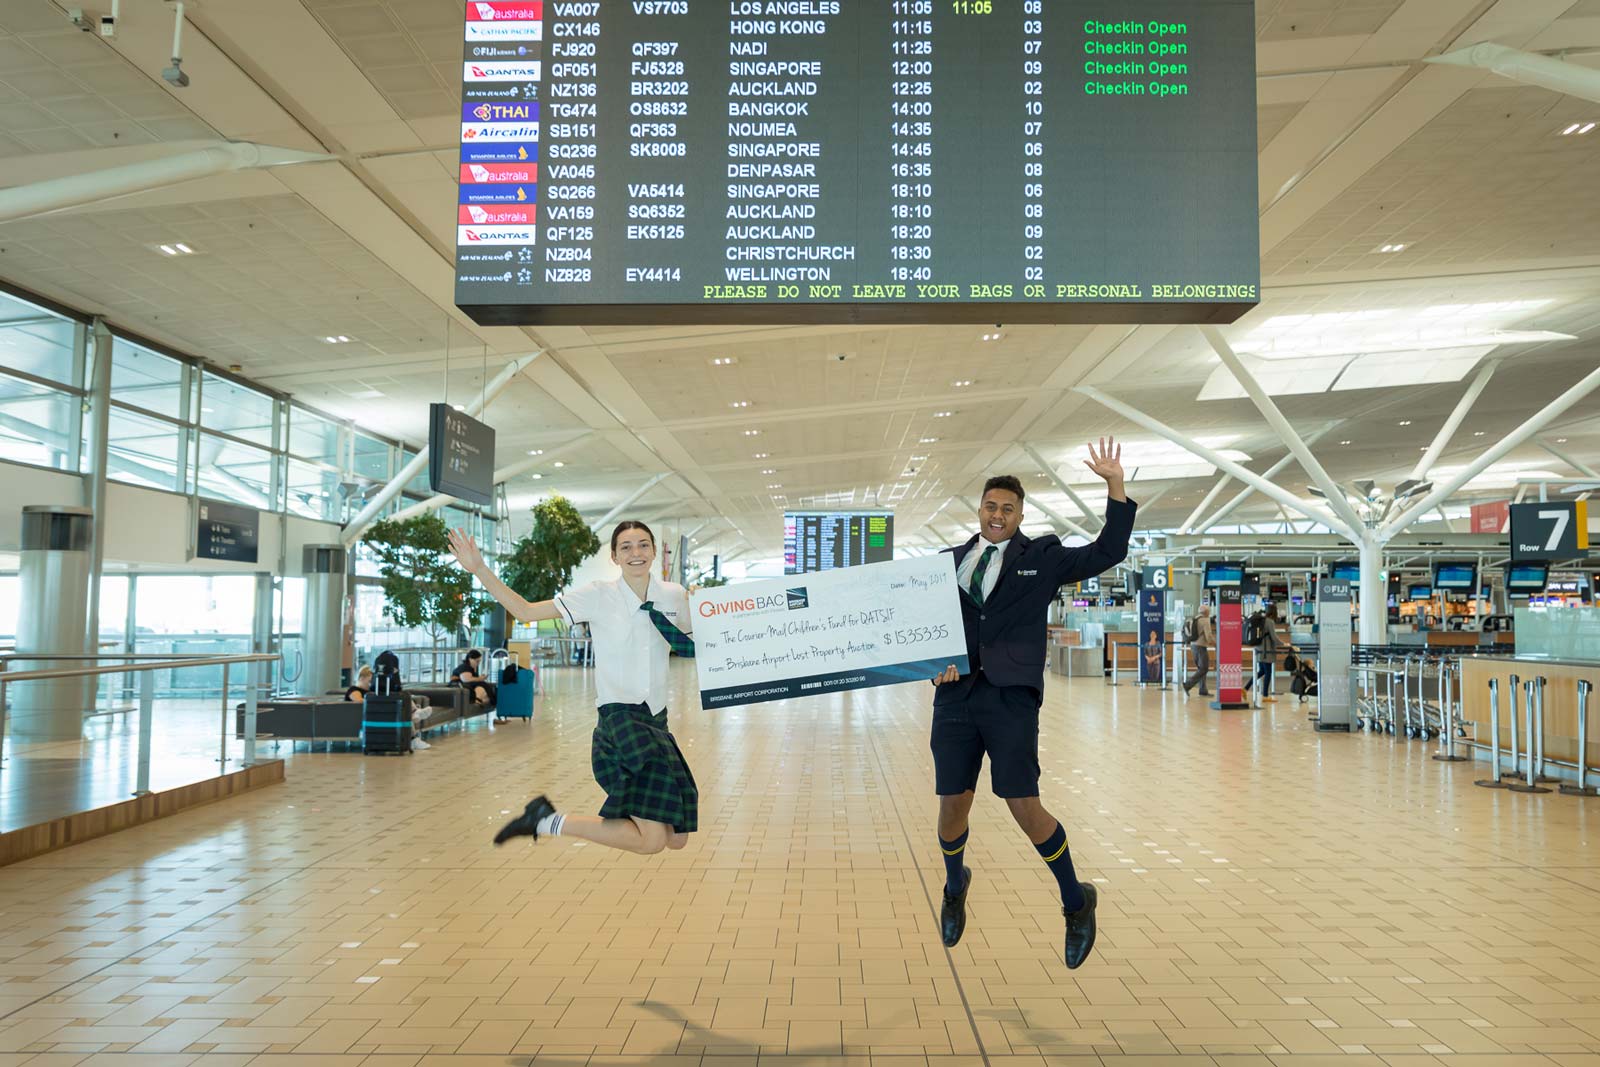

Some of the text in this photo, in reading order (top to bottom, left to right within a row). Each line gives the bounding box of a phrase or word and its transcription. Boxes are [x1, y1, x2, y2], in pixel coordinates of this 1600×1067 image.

[495, 9, 534, 18] australia
[554, 0, 1042, 16] VA007 VS7703 LOS ANGELES 11:05 11:05 08
[554, 20, 1186, 36] CX146 HONG KONG 11:15 03 Checkin Open
[552, 40, 1186, 56] FJ920 QF397 NADI 11:25 07 Checkin Open
[552, 60, 1186, 78] QF051 FJ5328 SINGAPORE 12:00 09 Checkin Open
[552, 82, 1188, 96] NZ136 BR3202 AUCKLAND 12:25 02 Checkin Open
[493, 106, 528, 118] THAI
[550, 102, 1042, 118] TG474 OS8632 BANGKOK 14:00 10
[479, 128, 538, 137] Aircalin
[550, 122, 1042, 138] SB151 QF363 NOUMEA 14:35 07
[550, 142, 1042, 158] SQ236 SK8008 SINGAPORE 14:45 06
[488, 172, 528, 181] australia
[548, 162, 1042, 178] VA045 DENPASAR 16:35 08
[548, 184, 1042, 200] SQ266 VA5414 SINGAPORE 18:10 06
[488, 213, 527, 222] australia
[546, 204, 1042, 220] VA159 SQ6352 AUCKLAND 18:10 08
[546, 224, 1042, 242] QF125 EK5125 AUCKLAND 18:20 09
[546, 246, 1042, 262] NZ804 CHRISTCHURCH 18:30 02
[546, 266, 1042, 282] NZ828 EY4414 WELLINGTON 18:40 02
[704, 286, 766, 298] PLEASE
[778, 286, 800, 298] DO
[810, 286, 842, 298] NOT
[852, 284, 906, 298] LEAVE
[916, 284, 960, 298] YOUR
[970, 284, 1012, 298] BAGS
[1024, 284, 1046, 298] OR
[1056, 284, 1142, 298] PERSONAL
[1538, 510, 1570, 551] 7
[1088, 578, 1098, 592] 5
[1153, 569, 1166, 588] 6
[700, 599, 754, 617] GIVING
[757, 594, 784, 609] BAC
[720, 631, 736, 644] The
[828, 616, 846, 629] Fund
[848, 614, 858, 627] for
[884, 633, 892, 645] $
[726, 641, 875, 670] Brisbane Airport Lost Property Auction
